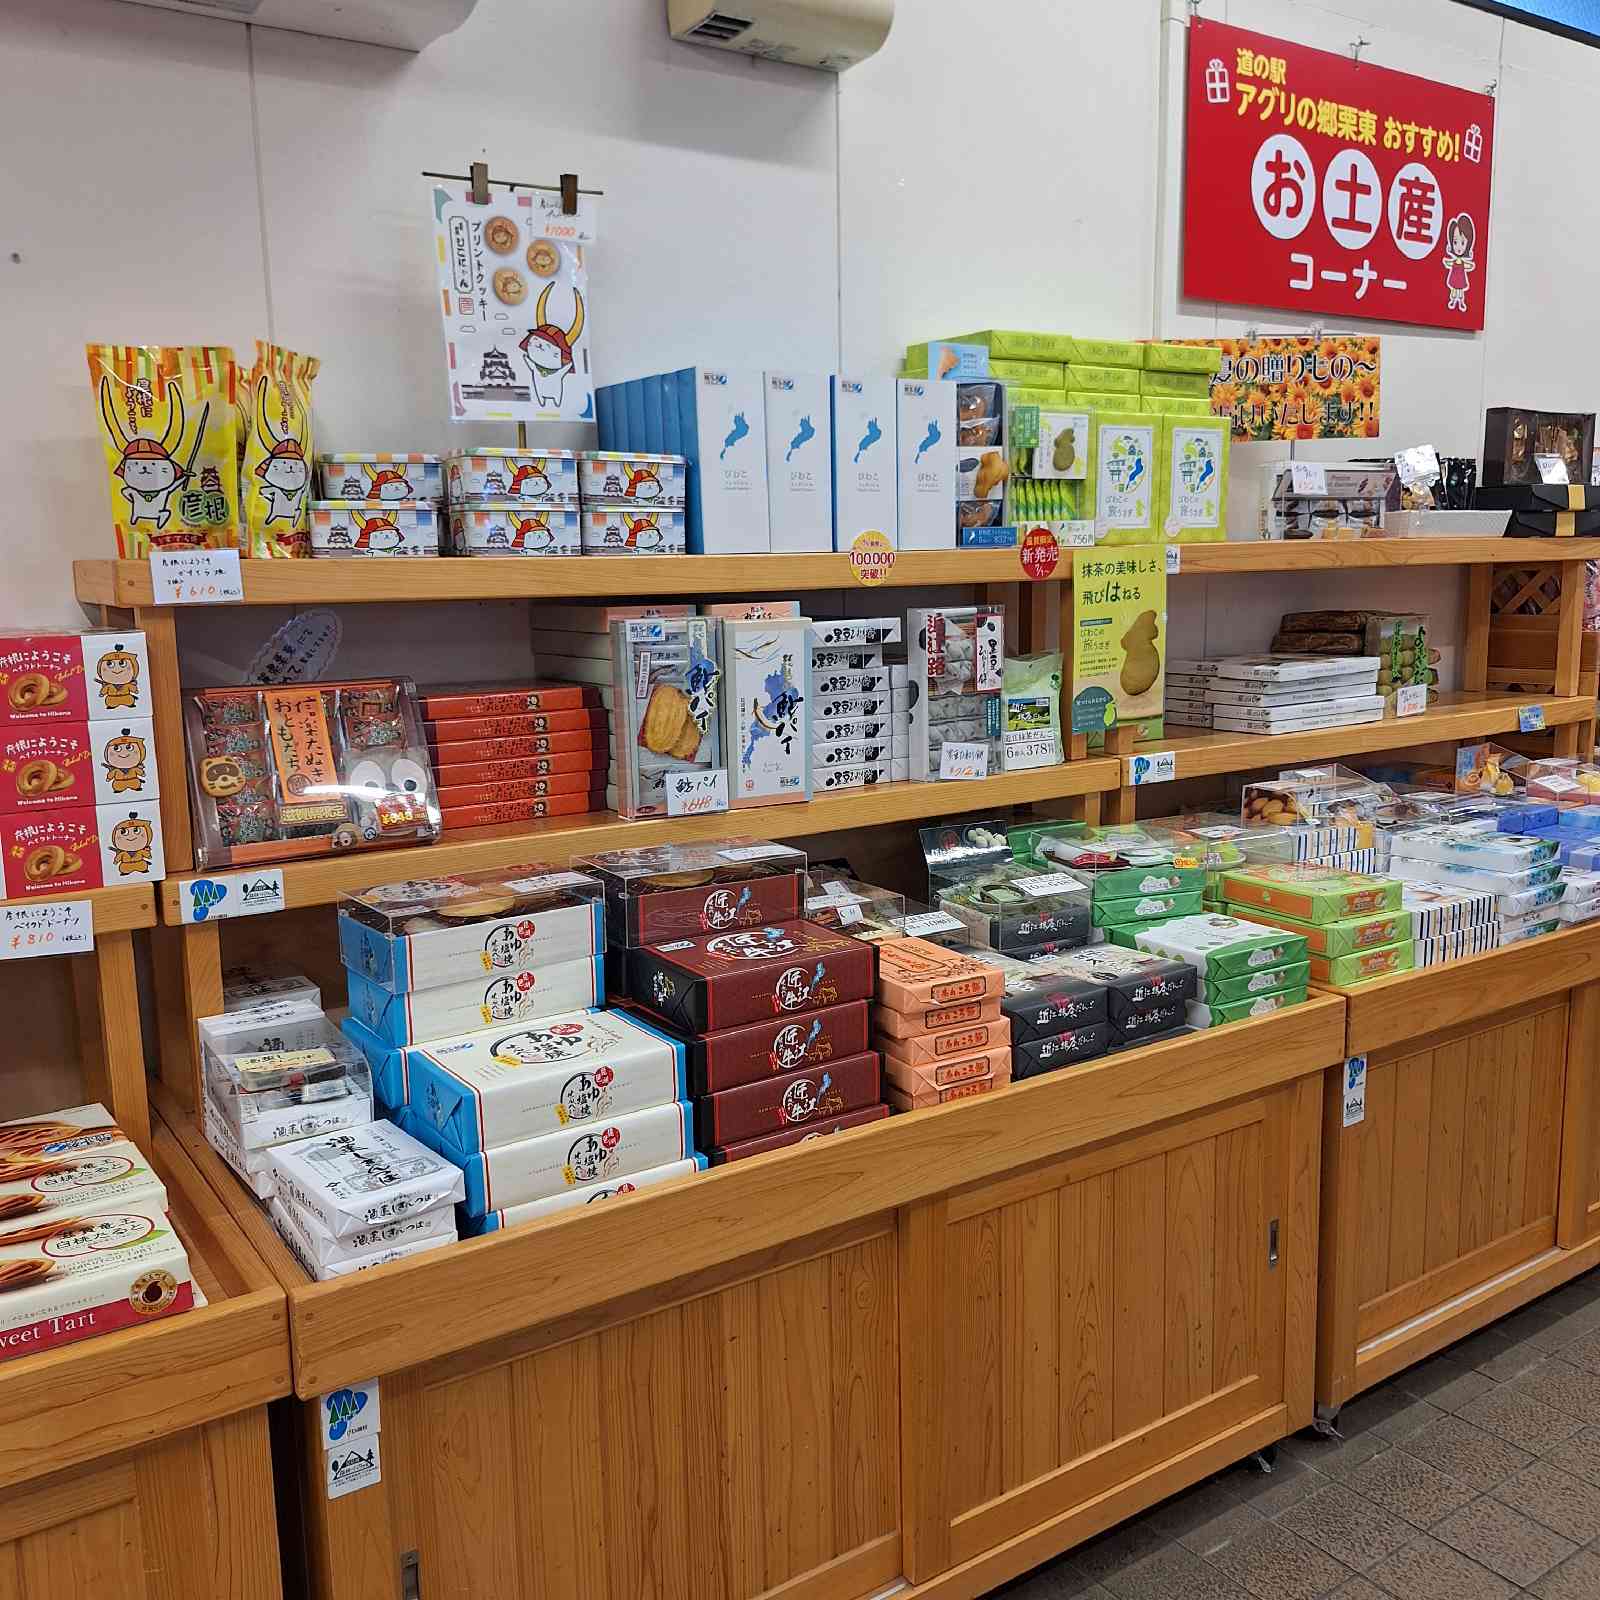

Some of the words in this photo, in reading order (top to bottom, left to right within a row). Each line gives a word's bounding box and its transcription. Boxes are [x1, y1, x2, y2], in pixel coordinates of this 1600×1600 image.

[1236, 48, 1287, 85] 道の駅
[1235, 82, 1377, 146] アグリの郷栗東
[1383, 116, 1460, 163] おすすめ!
[1262, 149, 1436, 244] お土産
[471, 221, 488, 321] プリントクッキー
[1289, 251, 1407, 300] コーナー
[181, 493, 227, 522] 彦根
[1022, 546, 1058, 564] 新発売
[1082, 559, 1162, 579] 抹茶の美味しさ、
[1083, 580, 1141, 605] 飛びはねる
[0, 648, 72, 667] 彦根にようこそ
[6, 736, 79, 754] 彦根にようこそ
[274, 697, 301, 773] おともだち
[295, 696, 326, 784] 信楽たぬき
[14, 822, 87, 841] 彦根にようこそ
[502, 927, 522, 951] あゆ
[502, 979, 522, 1003] あゆ
[1036, 999, 1095, 1024] 近江抹茶だんご
[1039, 1032, 1096, 1058] 近江抹茶だんご
[579, 1074, 600, 1102] あゆ
[586, 1136, 607, 1164] あゆ
[56, 1225, 145, 1250] 白桃たると
[48, 1310, 97, 1336] Tart
